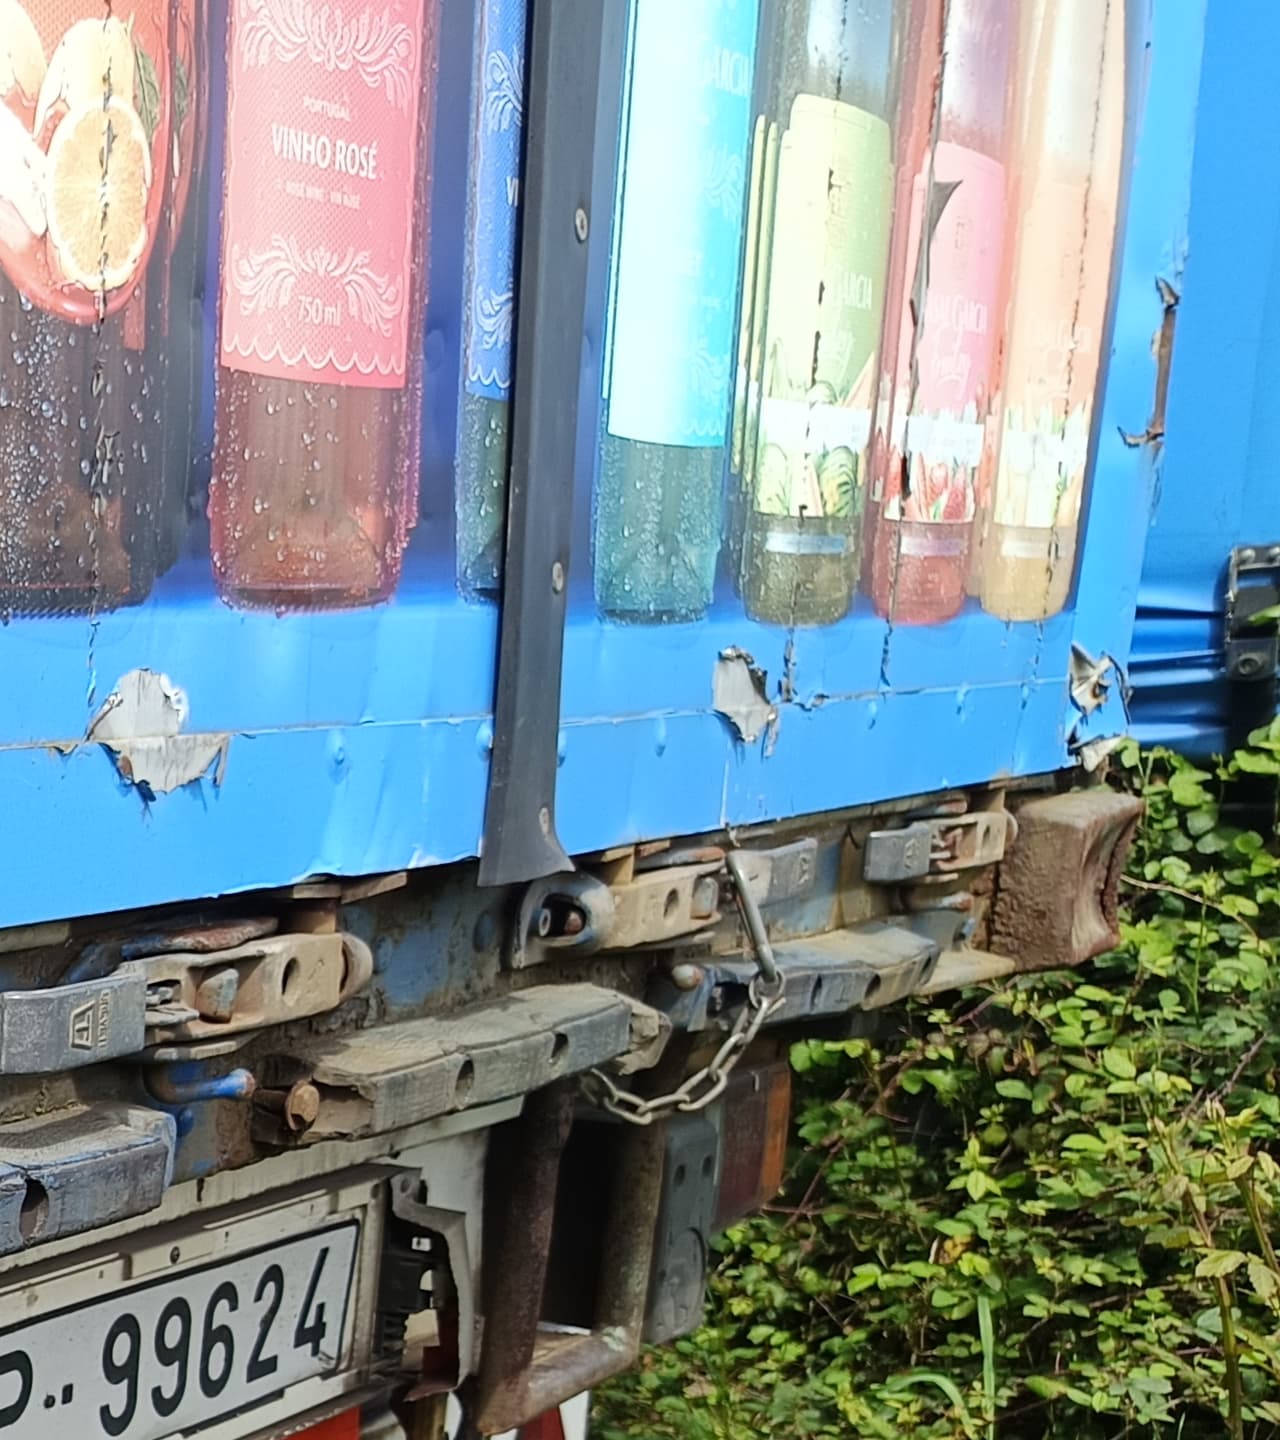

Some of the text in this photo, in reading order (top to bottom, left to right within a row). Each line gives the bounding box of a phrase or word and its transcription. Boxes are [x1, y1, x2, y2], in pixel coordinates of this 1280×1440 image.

[271, 122, 378, 180] VINHO ROSÉ
[297, 294, 341, 327] 750 ml
